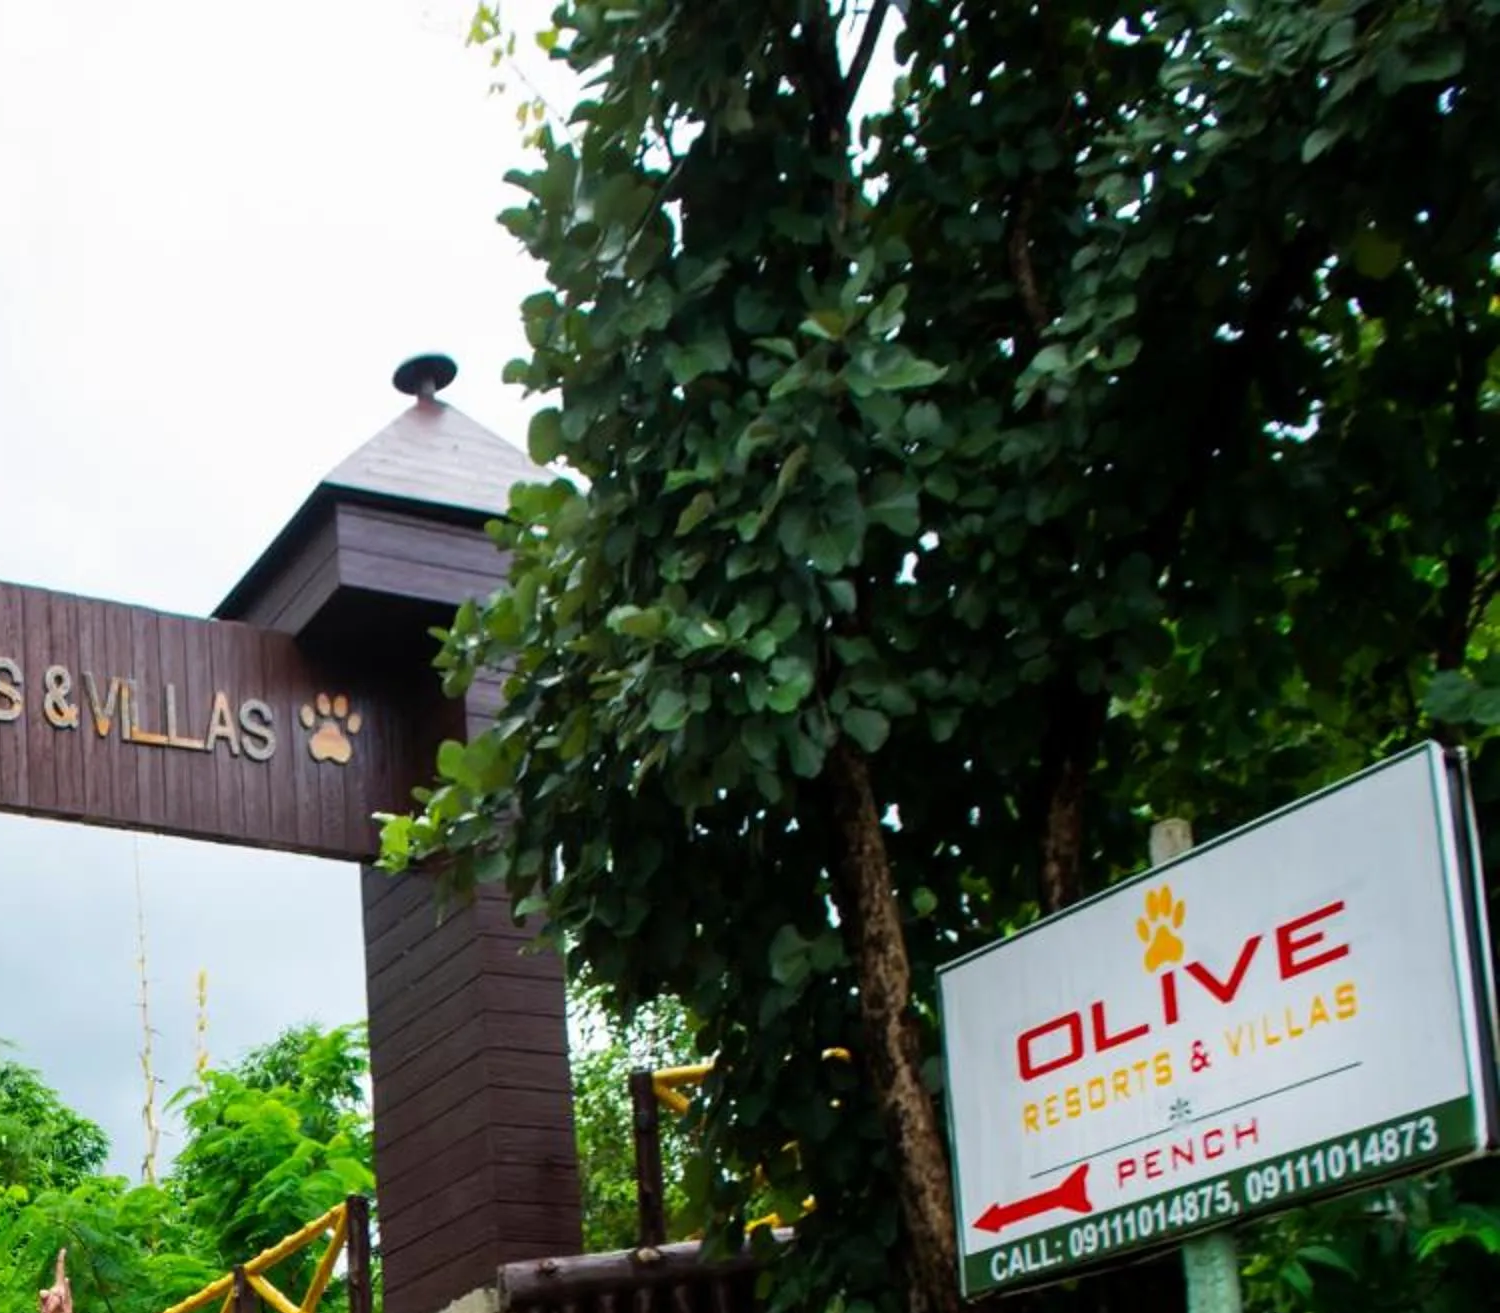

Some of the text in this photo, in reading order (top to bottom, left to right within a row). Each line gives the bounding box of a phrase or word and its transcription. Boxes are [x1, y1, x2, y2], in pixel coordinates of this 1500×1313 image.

[44, 664, 79, 728] &
[83, 671, 277, 761] VILLAS
[1016, 900, 1350, 1081] OLIVE
[1022, 983, 1357, 1134] RESORTS & VILLAS
[990, 1115, 1438, 1282] CALL: 09111014875, 09111014873
[1116, 1118, 1259, 1188] PENCH
